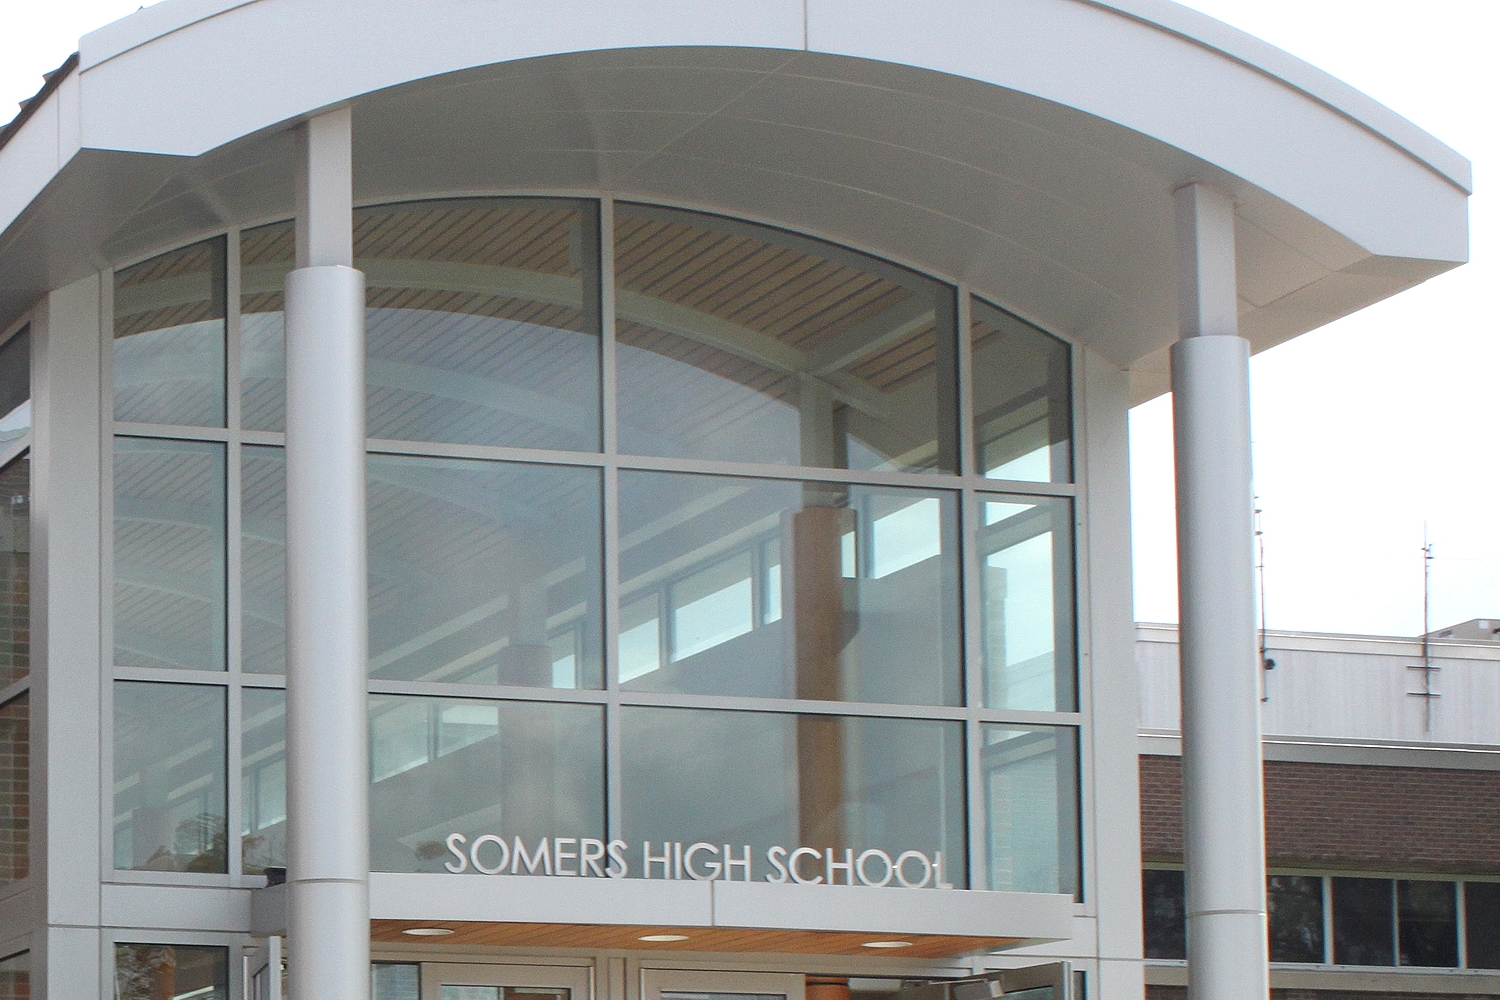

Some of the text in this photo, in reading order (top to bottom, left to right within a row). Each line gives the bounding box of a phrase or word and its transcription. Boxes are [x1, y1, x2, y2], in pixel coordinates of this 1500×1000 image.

[444, 833, 954, 890] SOMERS HIGH SCHOOL
